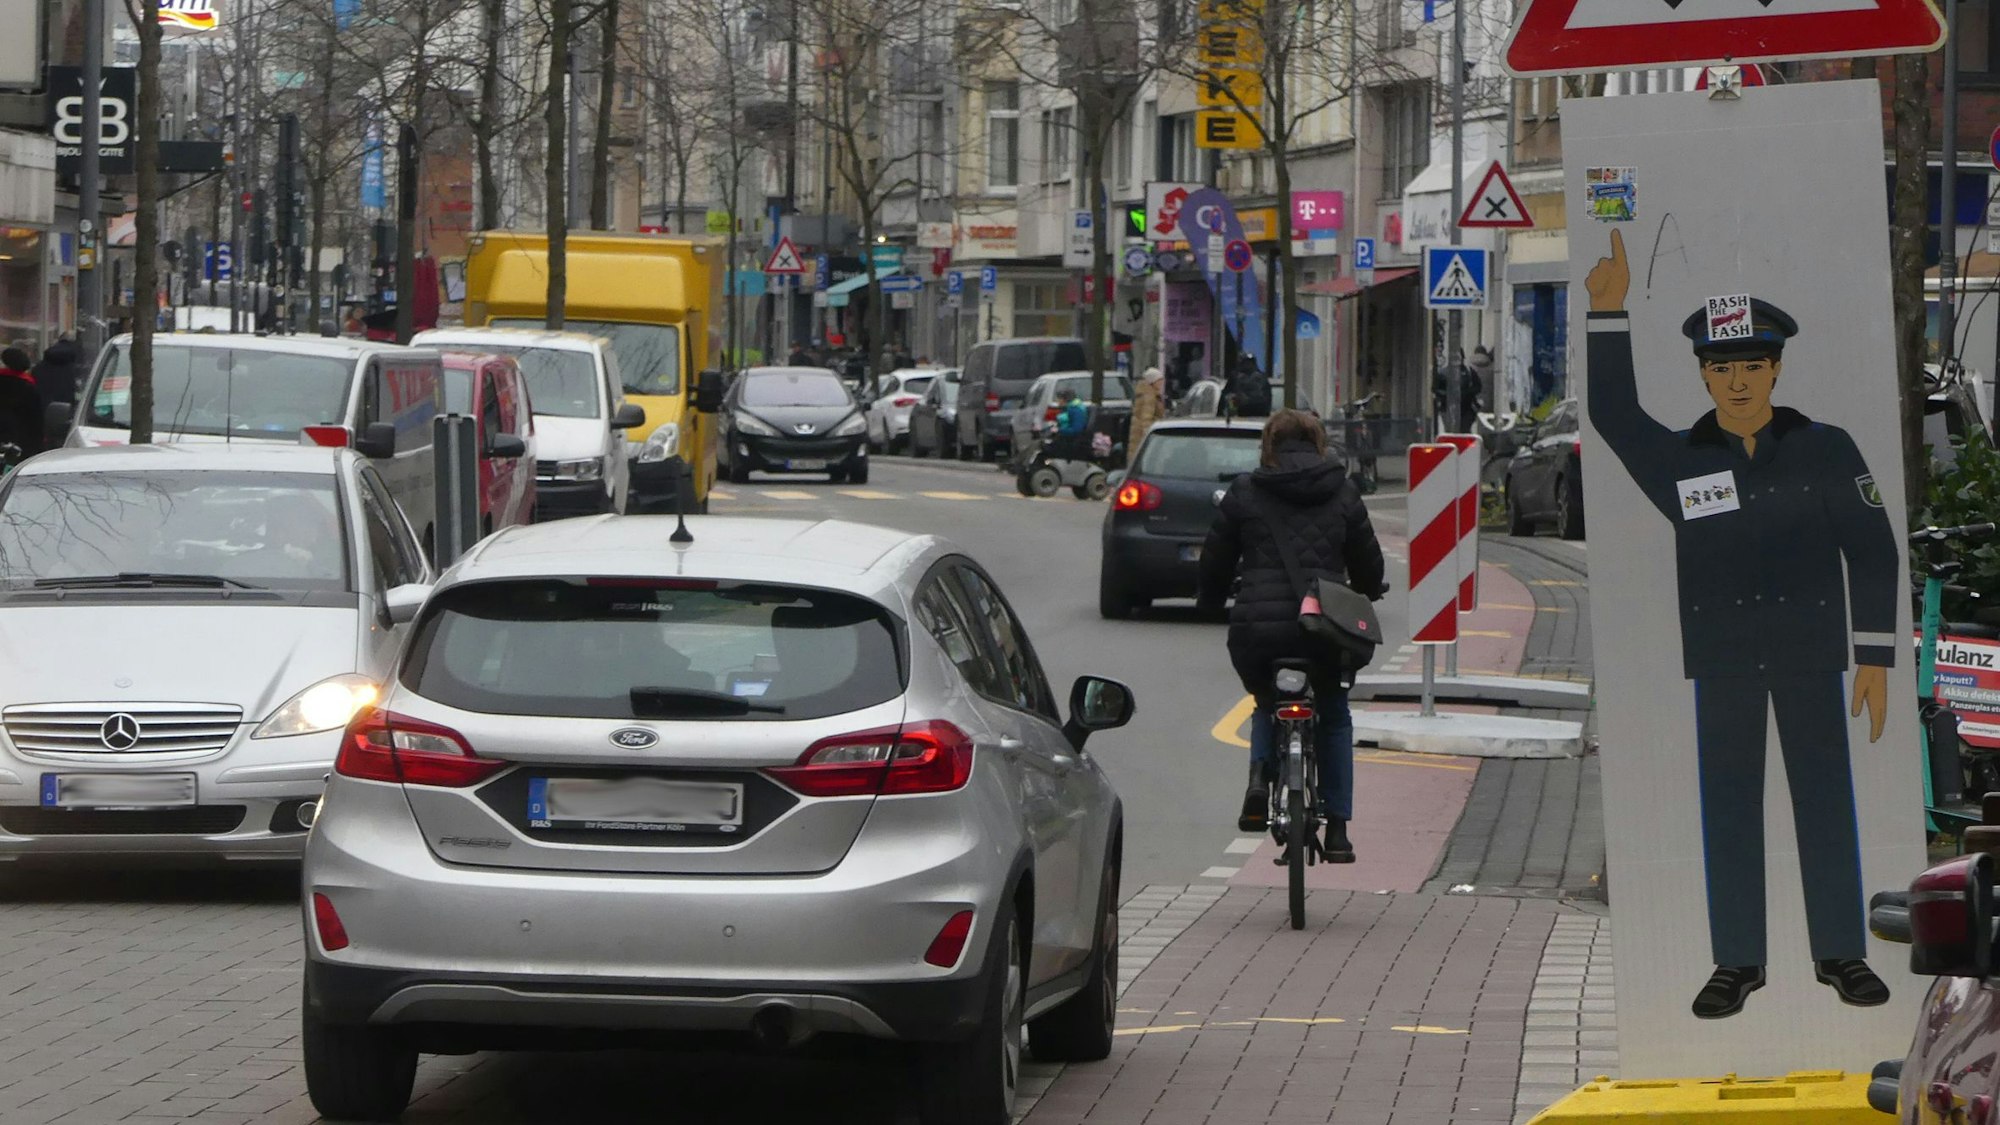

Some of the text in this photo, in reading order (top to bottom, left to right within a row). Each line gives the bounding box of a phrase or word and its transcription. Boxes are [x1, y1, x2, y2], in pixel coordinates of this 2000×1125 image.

[1709, 296, 1748, 309] BASH
[1710, 308, 1727, 316] THE
[1712, 324, 1750, 339] FASH
[1934, 644, 1995, 668] ulanz
[1940, 674, 1974, 685] kaputt?
[1943, 686, 1969, 699] Akku
[1950, 700, 1990, 712] Panzerglas
[619, 731, 648, 744] Ford
